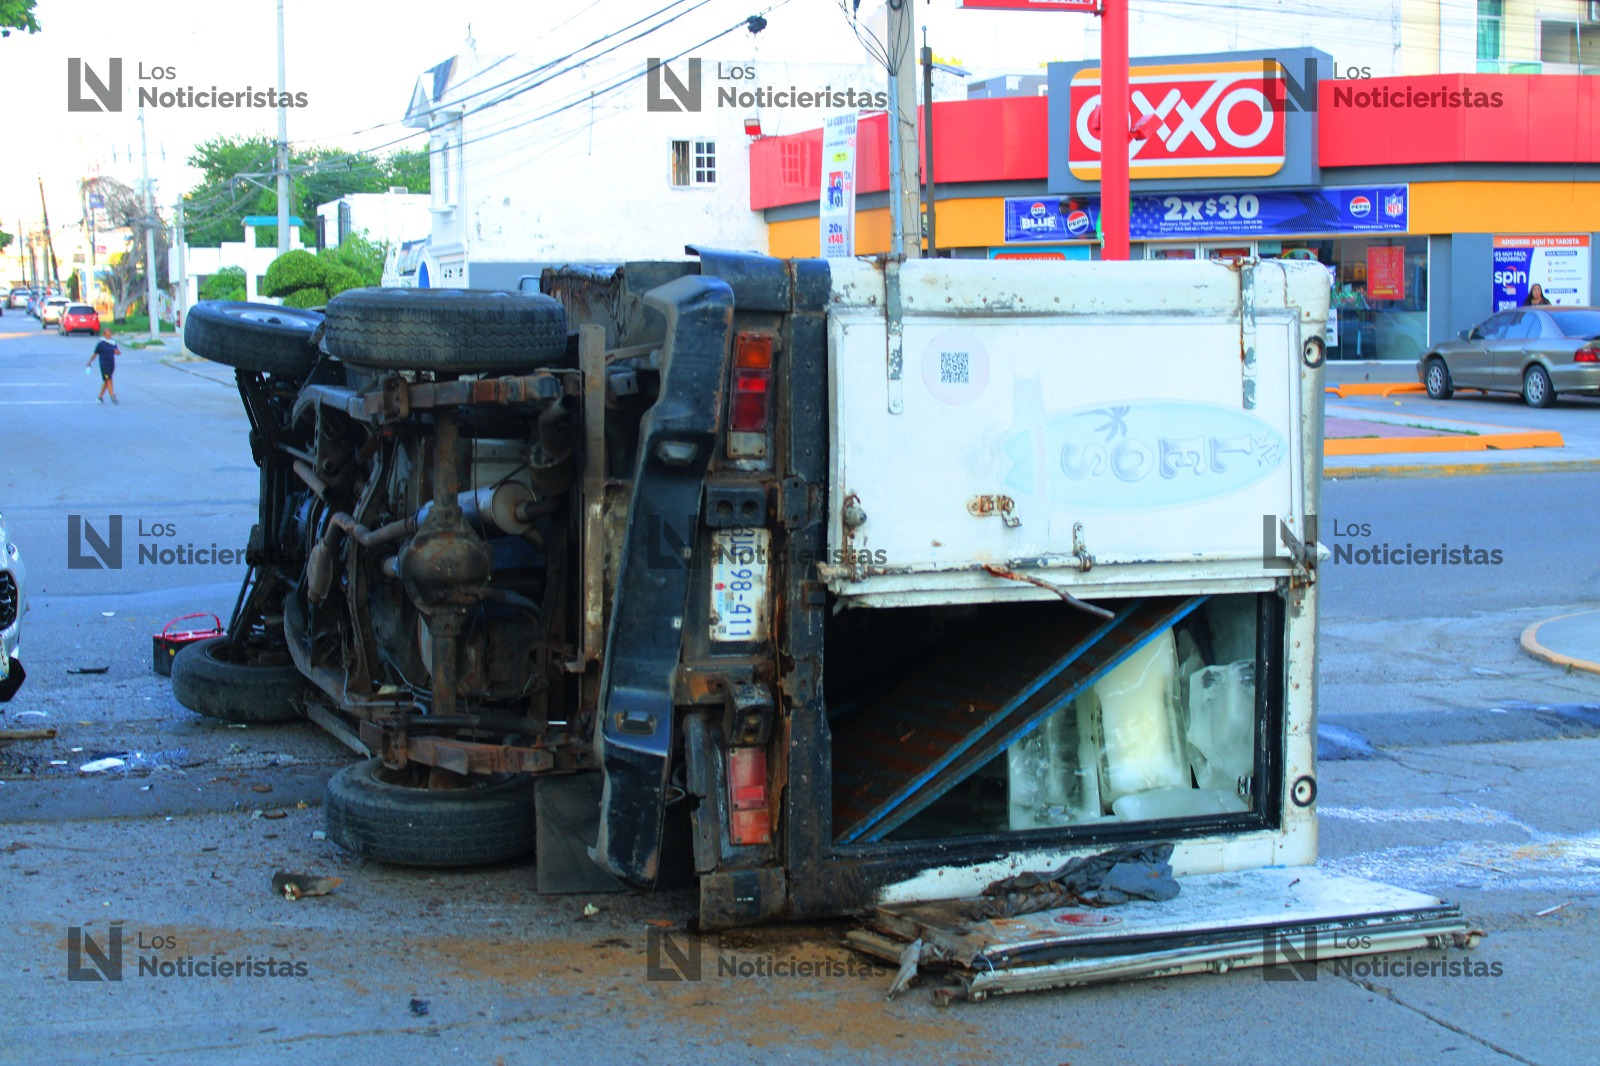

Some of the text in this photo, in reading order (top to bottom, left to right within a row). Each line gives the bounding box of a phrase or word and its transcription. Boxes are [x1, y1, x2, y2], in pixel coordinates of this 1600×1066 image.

[1388, 203, 1402, 214] NFL
[829, 223, 842, 233] 20x
[1021, 216, 1055, 230] BLUE
[828, 233, 844, 244] $145
[1494, 268, 1527, 287] spin
